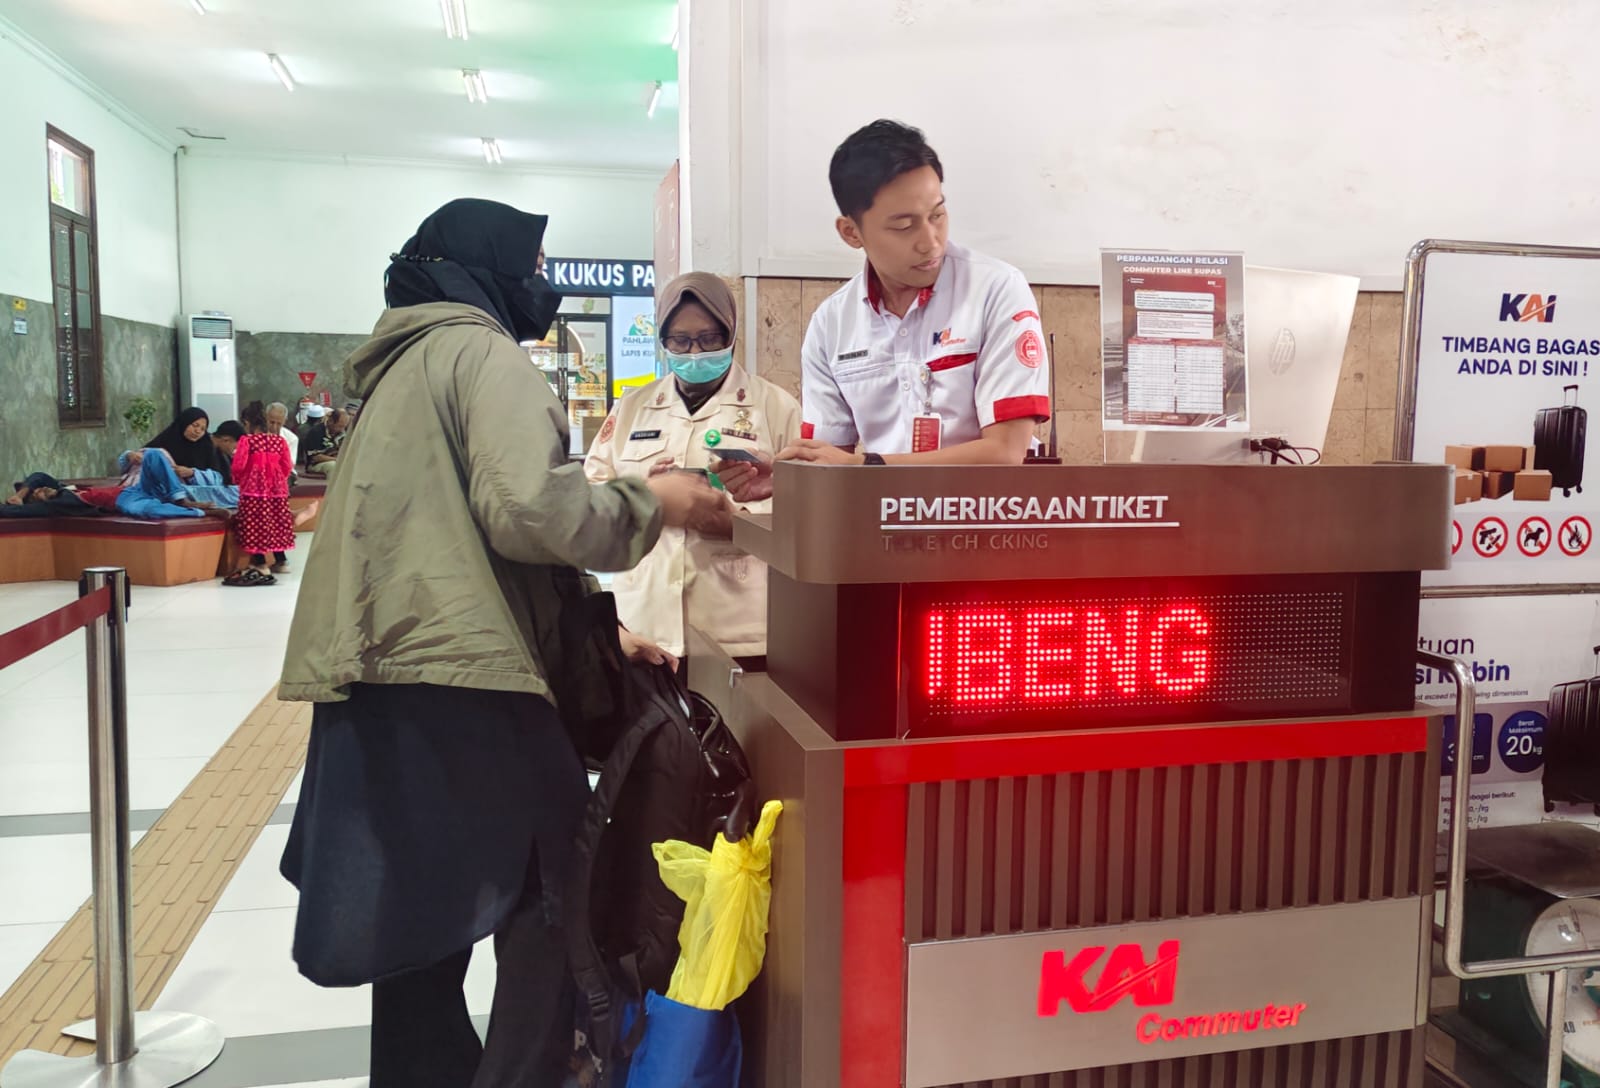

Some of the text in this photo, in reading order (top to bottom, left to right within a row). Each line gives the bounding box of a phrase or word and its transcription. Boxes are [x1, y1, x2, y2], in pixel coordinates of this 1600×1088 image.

[1117, 254, 1228, 266] PERPANJANGAN RELASI
[1123, 266, 1171, 274] COMMUTER
[554, 262, 625, 287] KUKUS
[632, 264, 655, 287] PA
[1499, 293, 1557, 323] KAI
[1442, 336, 1600, 356] TIMBANG BAGAS
[1457, 358, 1588, 377] ANDA DI SINI !
[880, 495, 1168, 521] PEMERIKSAAN TIKET
[951, 533, 1048, 550] CHCKING
[1438, 659, 1510, 684] Kbin
[1508, 726, 1543, 734] Maksimum
[1505, 735, 1543, 756] 20 kg
[1037, 939, 1181, 1018] KAI
[1136, 1002, 1306, 1045] Commuter
